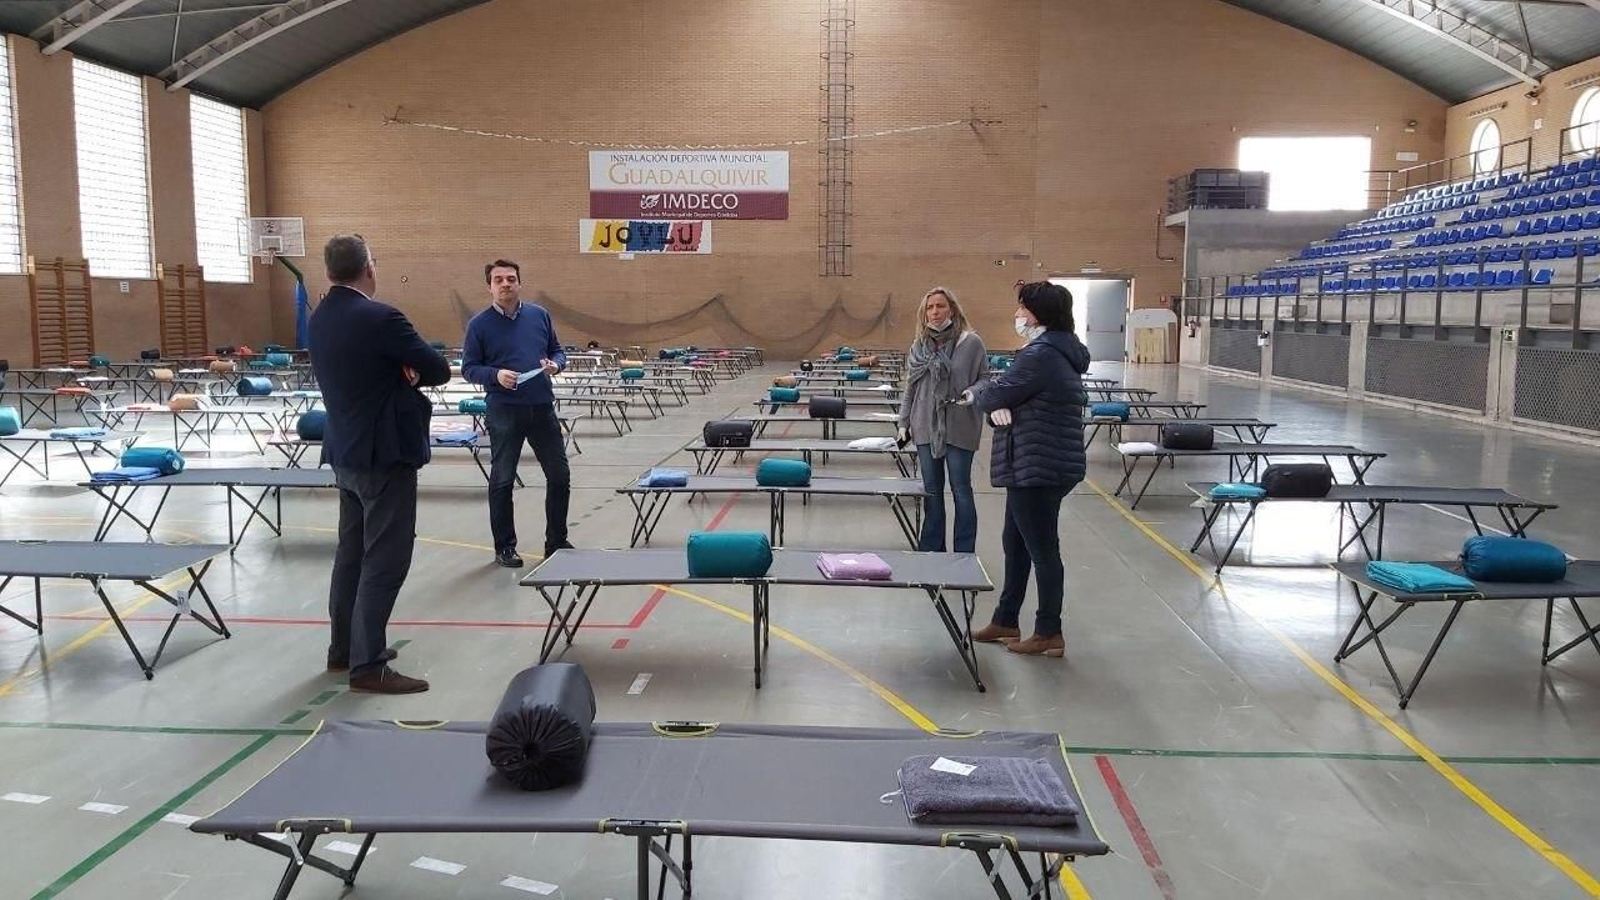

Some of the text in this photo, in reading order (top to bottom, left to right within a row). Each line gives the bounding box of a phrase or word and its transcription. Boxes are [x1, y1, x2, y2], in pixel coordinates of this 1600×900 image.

[610, 153, 768, 163] INSTALACIÓN DEPORTIVA MUNICIPAL
[663, 193, 739, 210] IMDECO
